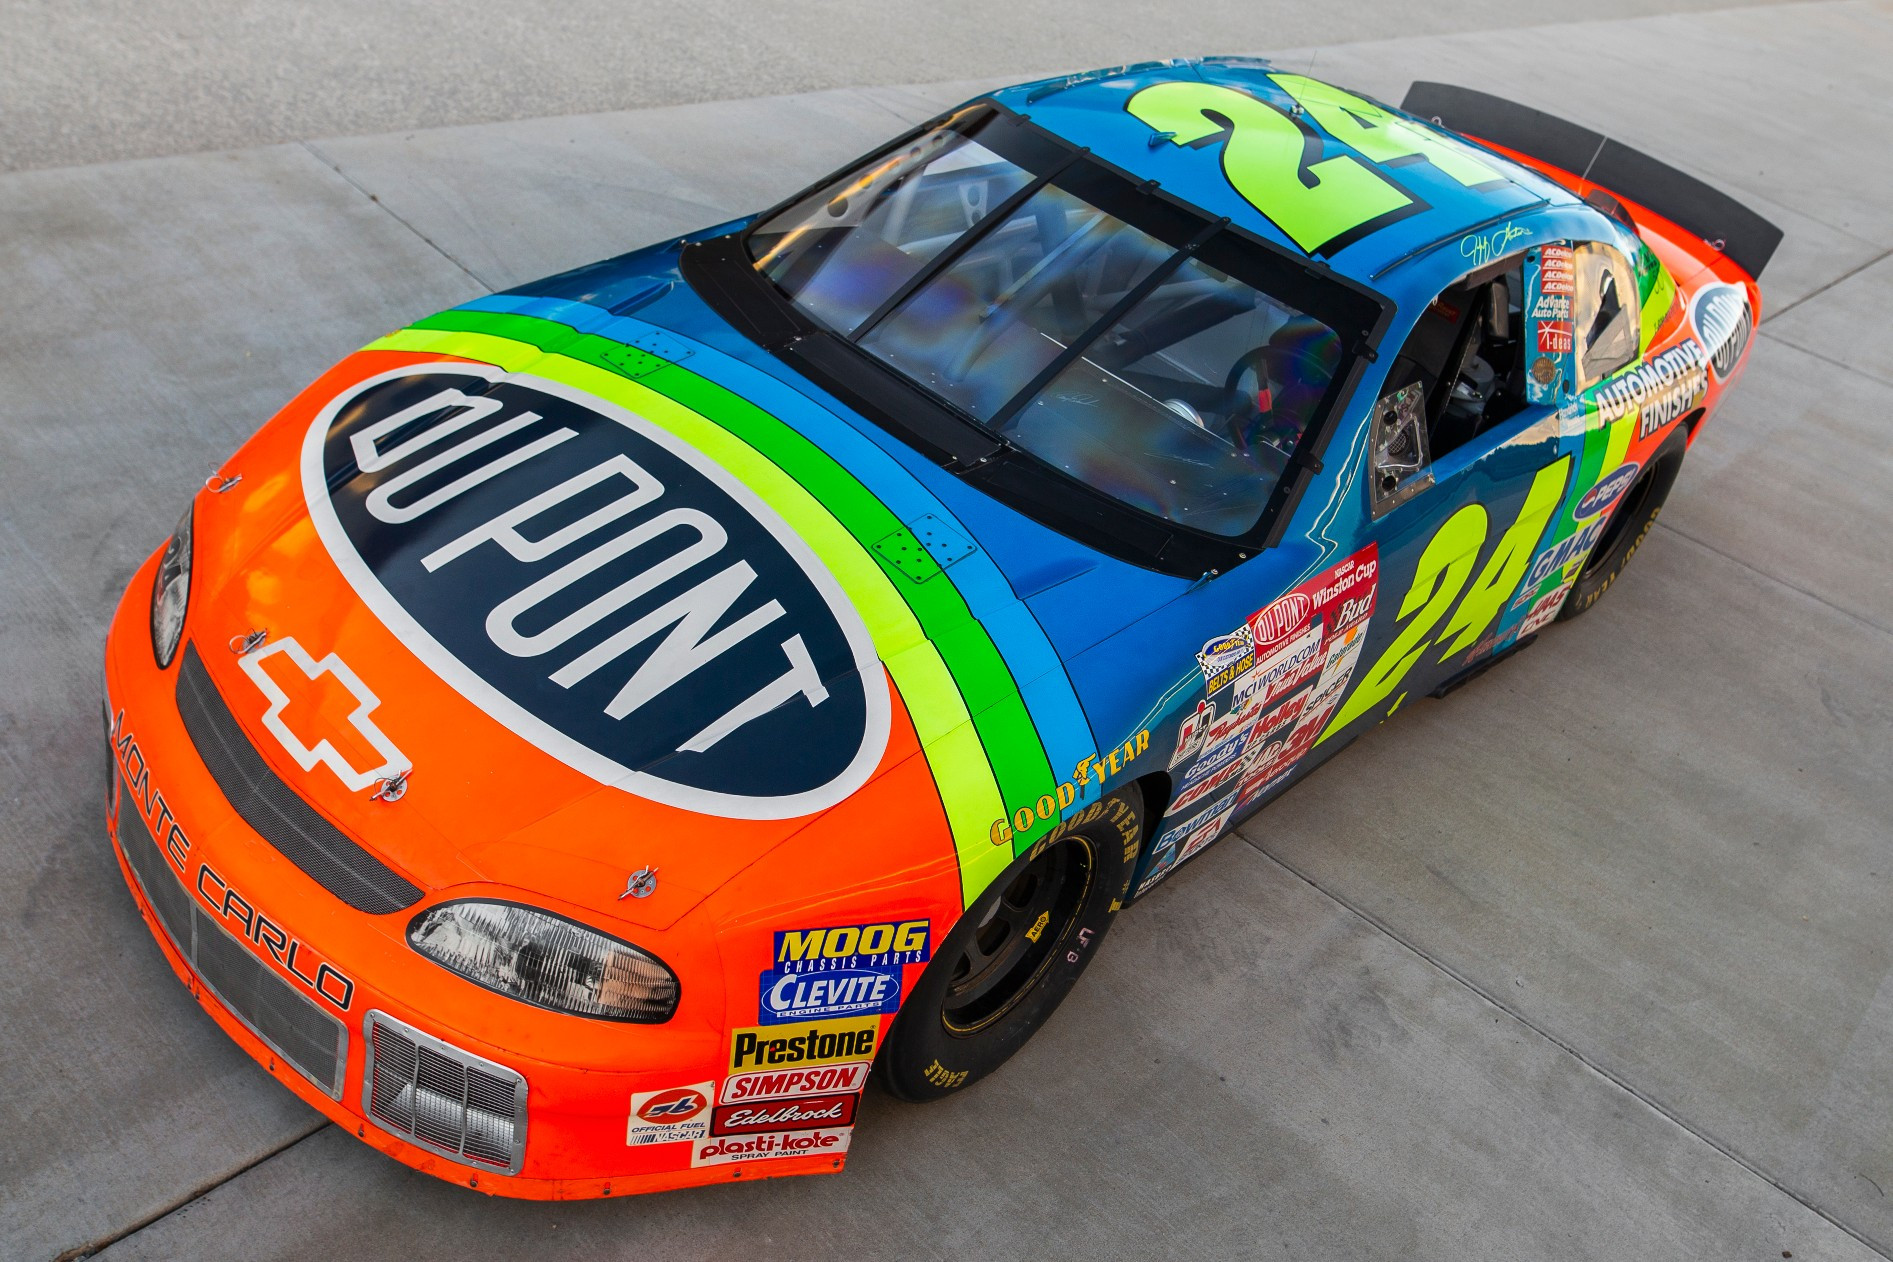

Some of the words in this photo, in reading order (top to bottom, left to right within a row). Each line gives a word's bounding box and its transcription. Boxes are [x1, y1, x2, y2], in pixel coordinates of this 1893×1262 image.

[1124, 72, 1508, 254] 24
[1532, 308, 1551, 318] Auto
[1594, 338, 1701, 430] AUTOMOTIVE
[1639, 373, 1708, 442] FINISHES
[1592, 467, 1636, 508] PEPSI
[1334, 560, 1355, 580] NASCAR
[1527, 515, 1604, 588] GMAC
[1311, 453, 1573, 750] 24
[1313, 574, 1355, 610] Winston
[1355, 559, 1377, 582] Cup
[1334, 583, 1377, 632] Bud
[1256, 640, 1289, 665] AUTOMOTIVE
[1289, 623, 1311, 643] FINISHES
[1208, 673, 1228, 694] BELTS
[1229, 669, 1235, 681] &
[1235, 652, 1254, 675] HOSE
[1232, 683, 1256, 706] MCI
[1258, 638, 1321, 688] WORLDCOM
[1303, 666, 1353, 716] SPICER
[1247, 692, 1309, 744] Holley
[1278, 704, 1335, 760] 3M
[1184, 732, 1250, 780] Goody's
[989, 728, 1151, 847] GOODYEAR
[1172, 758, 1242, 811] COMP
[1029, 796, 1138, 864] GOODYEAR
[1155, 791, 1238, 852] Bowman
[111, 708, 191, 873] MONTE
[196, 863, 355, 1012] CARLO
[777, 920, 929, 963] MOOG
[1031, 914, 1048, 938] AERO
[784, 955, 858, 974] CHASSIS
[870, 950, 923, 967] PARTS
[770, 973, 891, 1011] CLEVITE
[779, 1006, 831, 1017] ENGINE
[837, 1002, 881, 1011] PARTS
[733, 1029, 876, 1069] Prestone
[731, 1066, 859, 1099] SIMPSON
[923, 1058, 969, 1089] EAGLE
[631, 1124, 677, 1133] OFFICIAL
[680, 1122, 706, 1130] FUEL
[724, 1101, 844, 1129] Edelbrock
[699, 1131, 840, 1160] plasti-kote
[731, 1151, 770, 1161] SPRAY
[774, 1149, 809, 1158] PAINT
